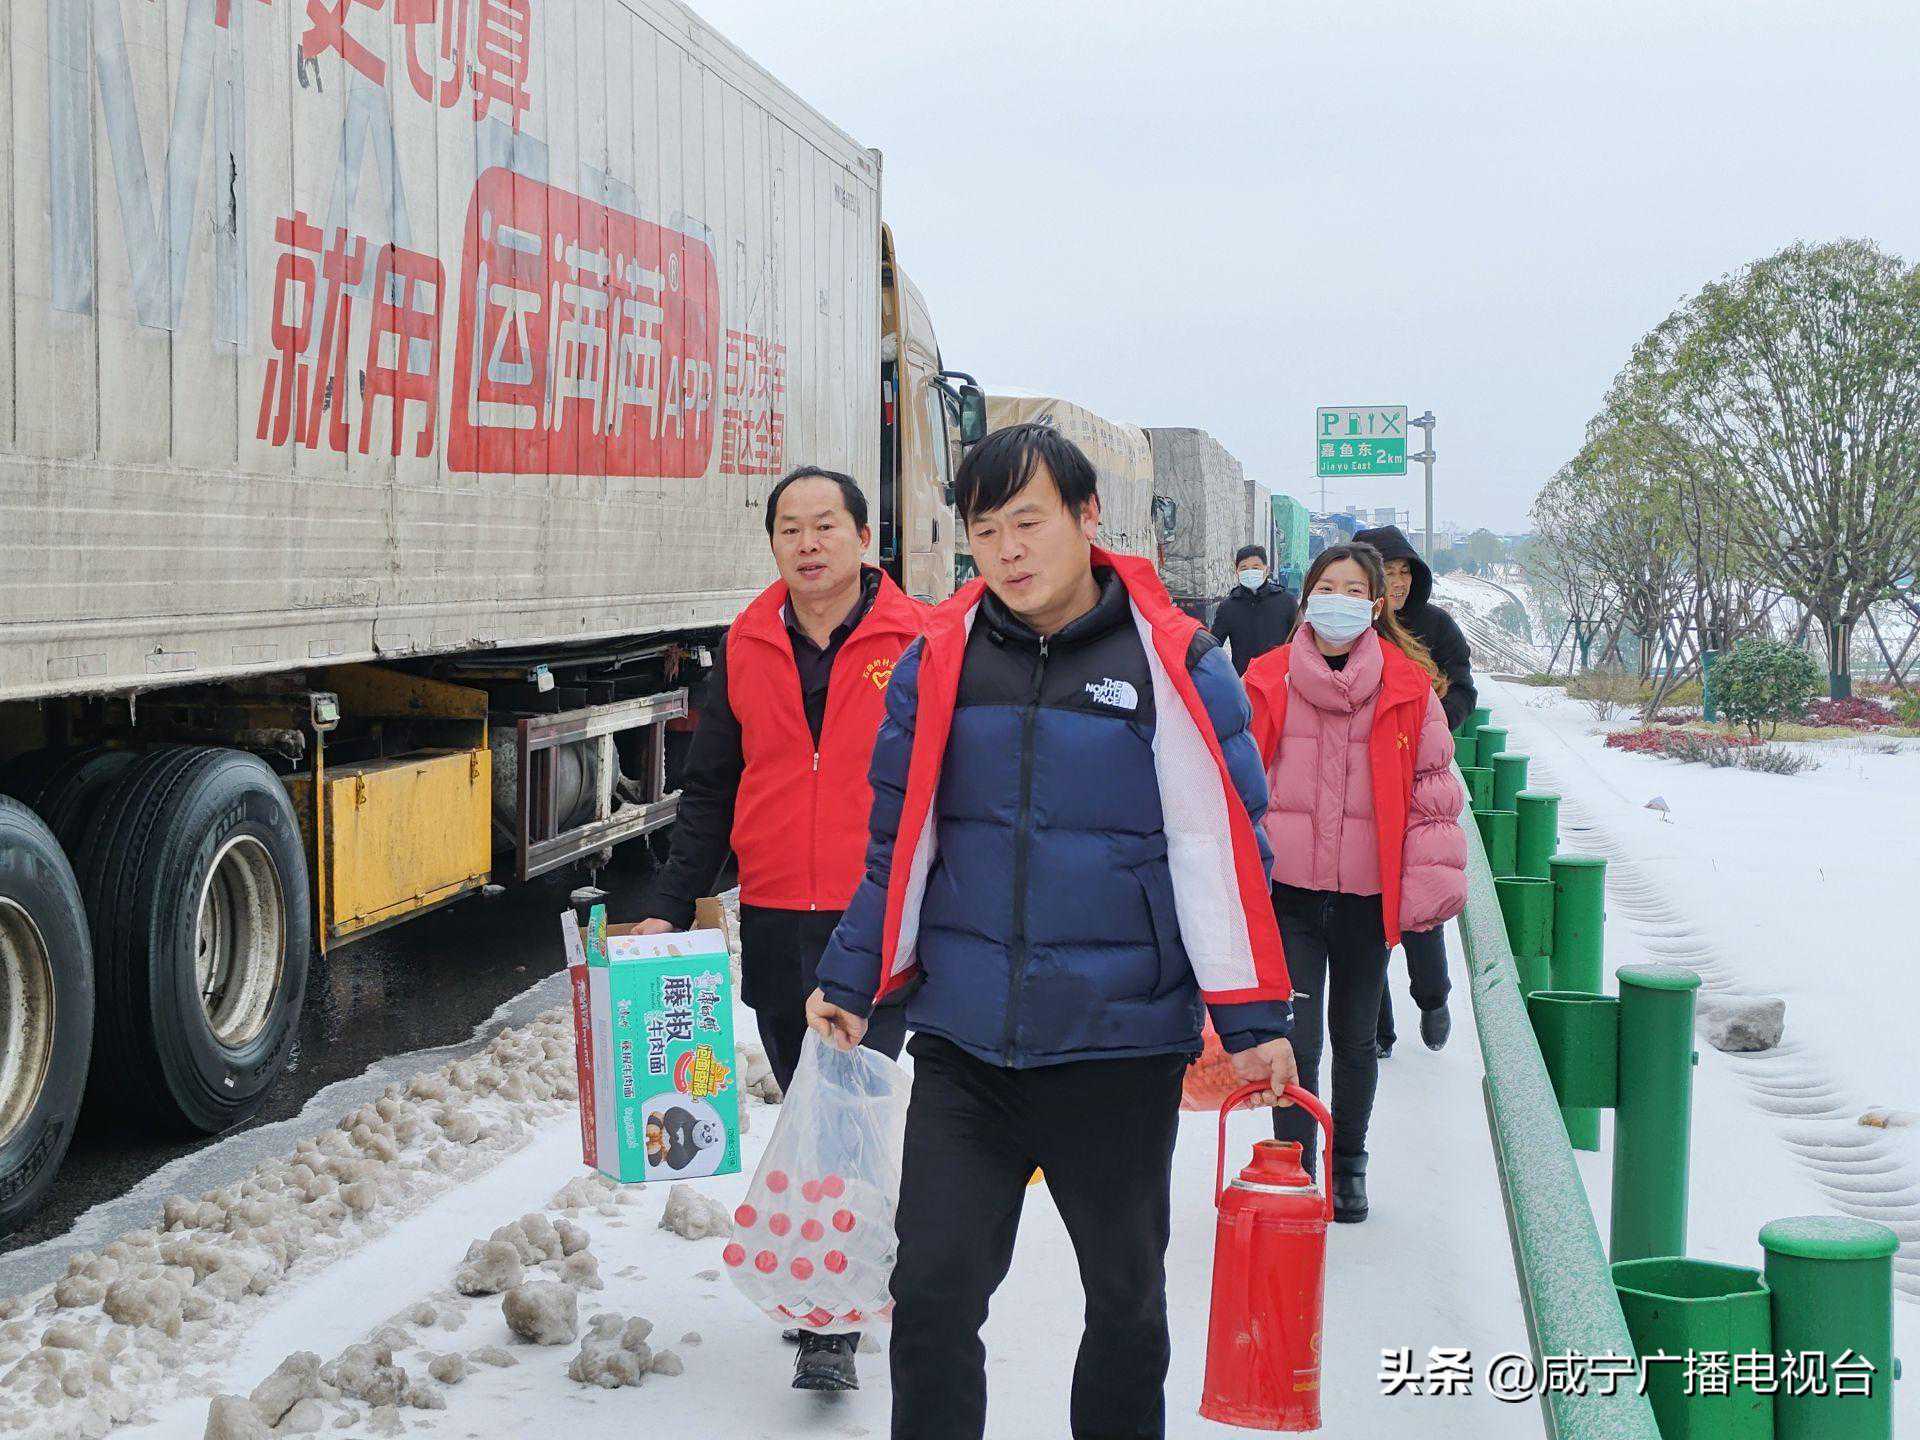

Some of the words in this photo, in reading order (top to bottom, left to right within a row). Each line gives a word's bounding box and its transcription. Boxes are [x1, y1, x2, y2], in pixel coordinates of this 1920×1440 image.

[257, 211, 446, 458] 就用
[468, 208, 666, 440] 运满满
[724, 329, 786, 402] 百万货车
[719, 407, 784, 475] 直达全国
[1321, 443, 1372, 457] 嘉鱼东
[1086, 683, 1121, 700] NORTH
[1093, 694, 1120, 706] FACE
[1103, 678, 1123, 689] THE
[662, 975, 693, 1042] 藤椒
[648, 1019, 667, 1075] 牛肉面
